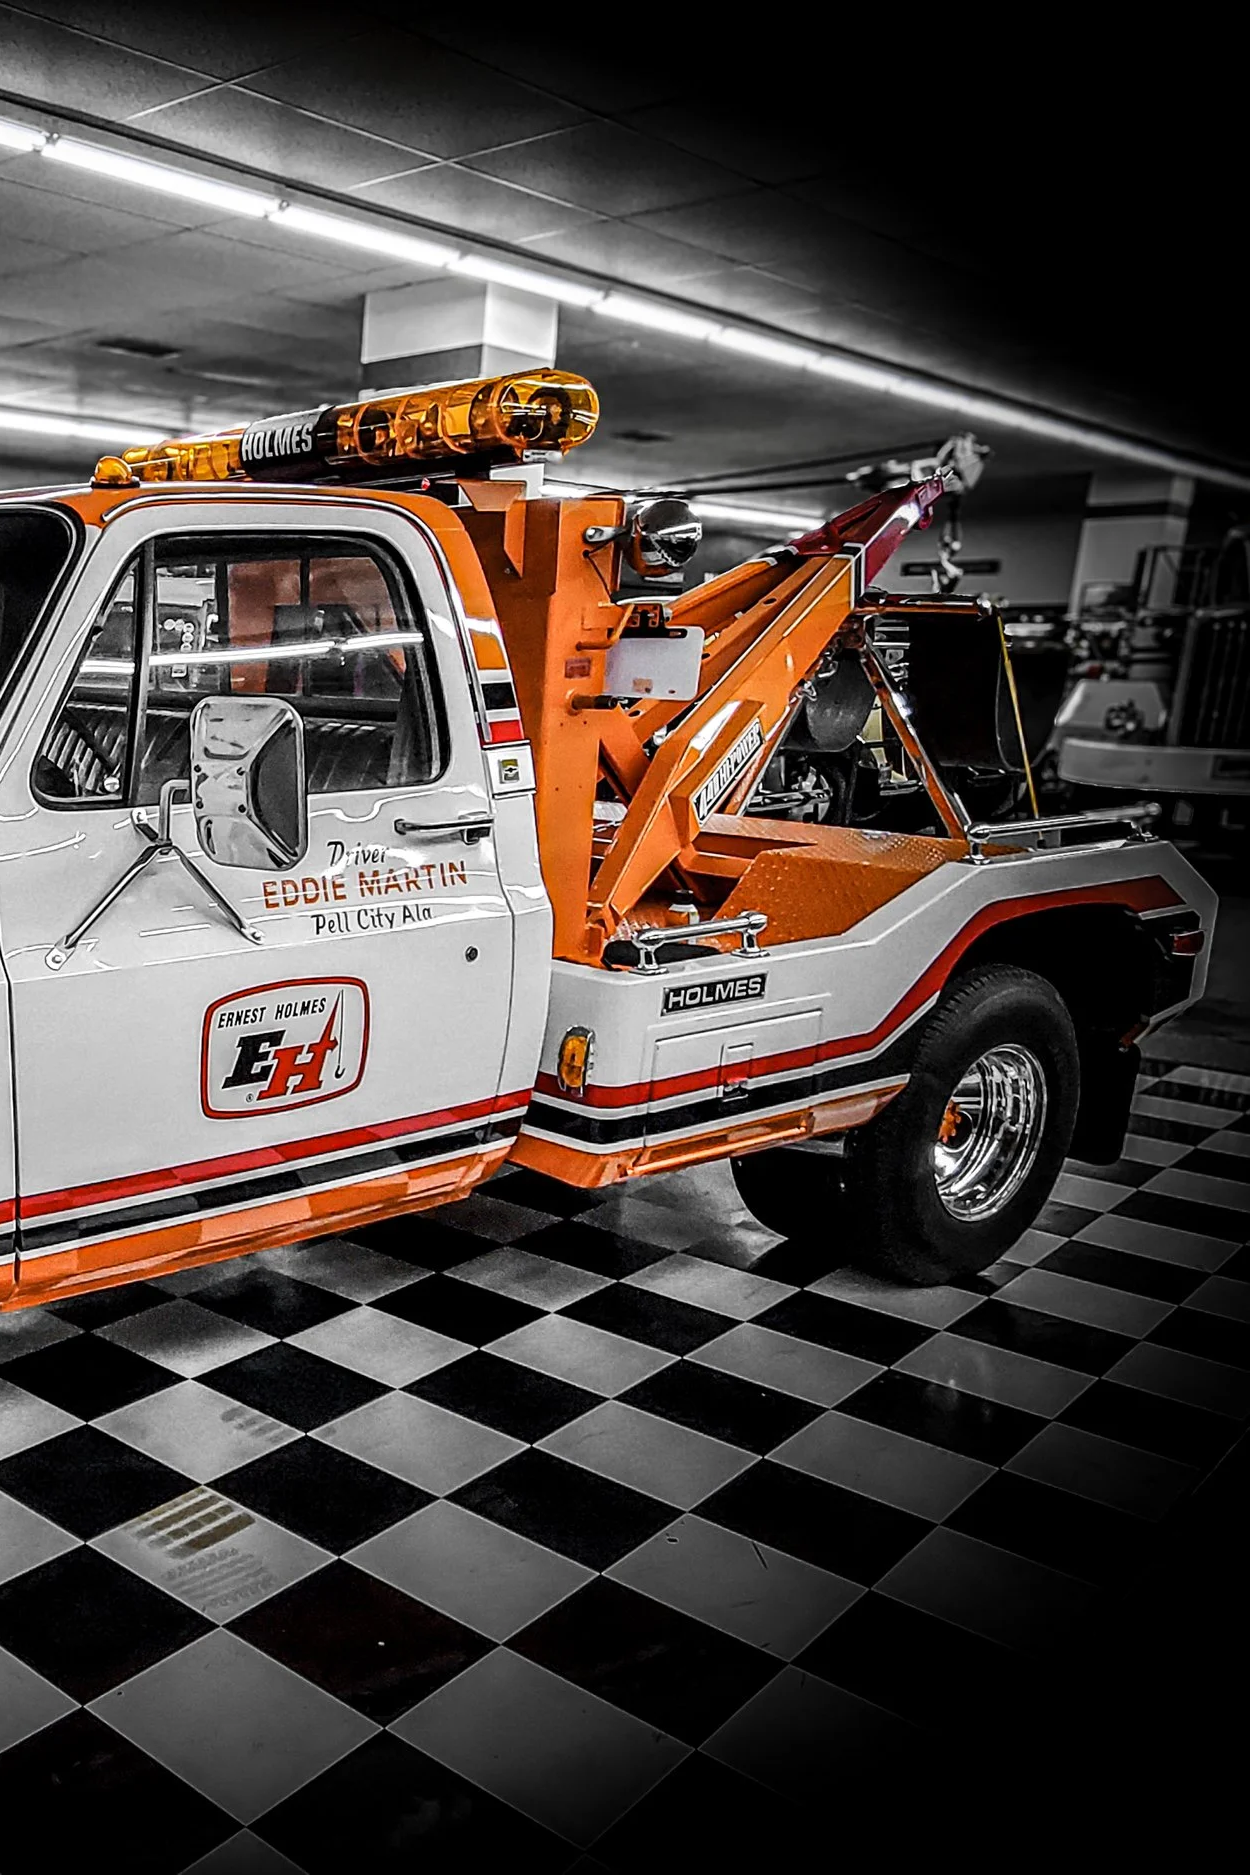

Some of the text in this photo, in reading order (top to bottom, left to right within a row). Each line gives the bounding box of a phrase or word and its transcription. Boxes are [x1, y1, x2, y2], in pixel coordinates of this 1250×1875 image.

[241, 423, 313, 462] HOLMES
[262, 860, 468, 909] EDDIE MARTIN
[311, 911, 350, 935] Pell
[357, 907, 395, 930] City
[668, 977, 762, 1009] HOLMES
[218, 997, 327, 1028] ERNEST HOLMES
